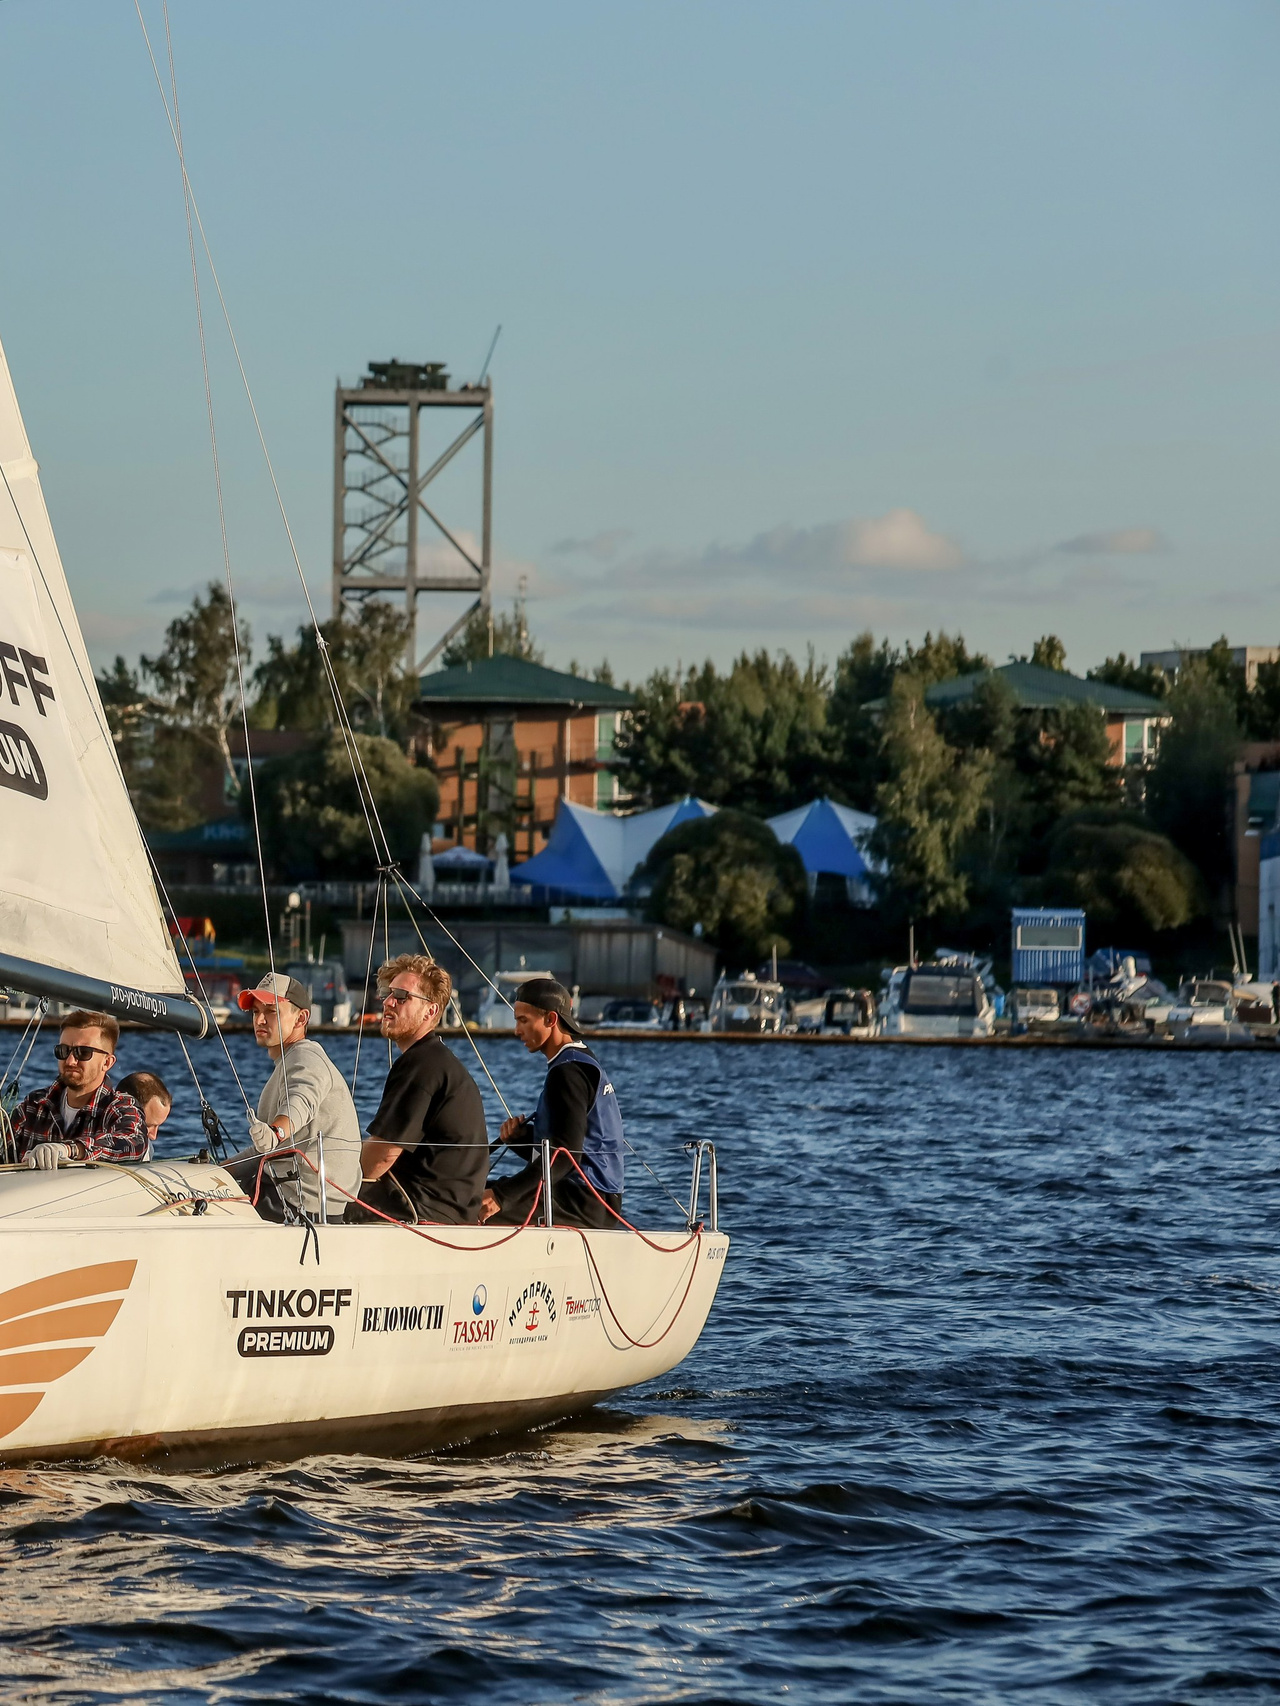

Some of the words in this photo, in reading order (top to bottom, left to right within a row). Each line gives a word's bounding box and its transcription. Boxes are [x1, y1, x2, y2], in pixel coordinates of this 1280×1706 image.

[110, 985, 167, 1018] pro-yachting.ru
[226, 1288, 352, 1319] TINKOFF
[508, 1280, 557, 1327] МОРПРИБОР
[361, 1304, 445, 1335] ВЕДОМОСТИ
[453, 1319, 499, 1344] TASSAY
[243, 1330, 330, 1352] PREMIUM
